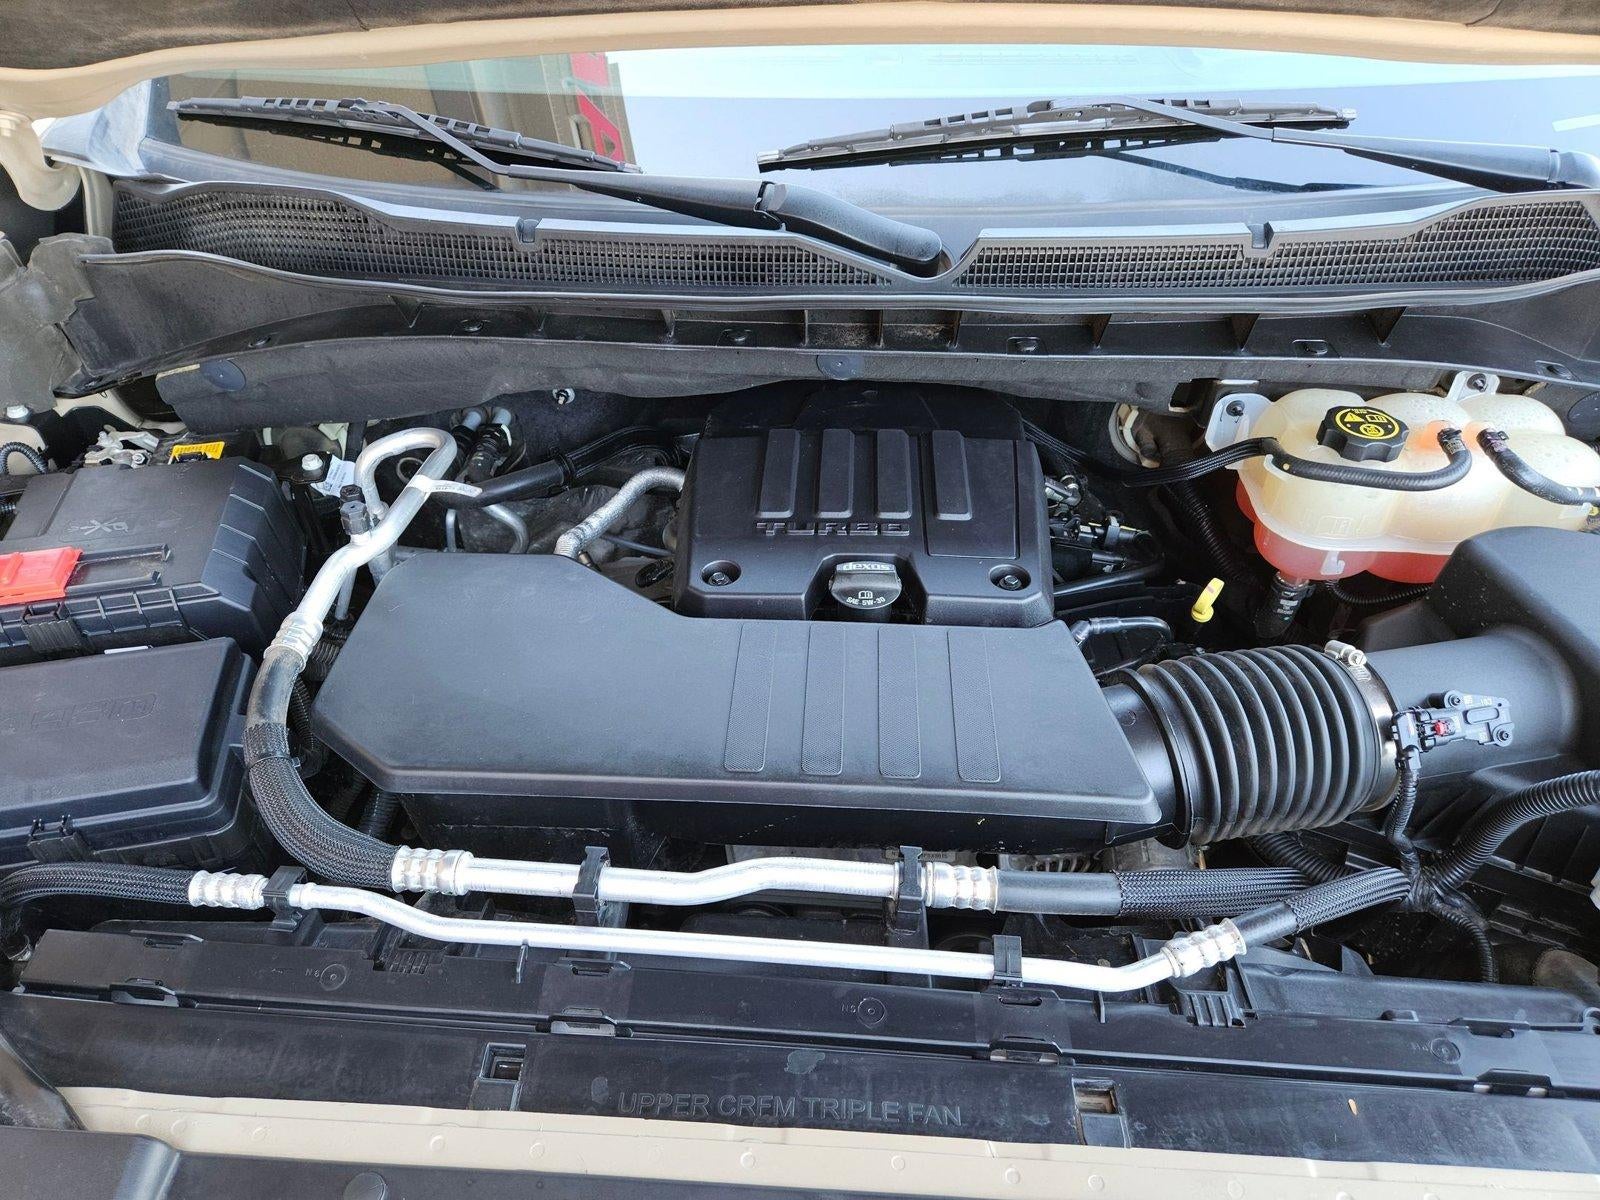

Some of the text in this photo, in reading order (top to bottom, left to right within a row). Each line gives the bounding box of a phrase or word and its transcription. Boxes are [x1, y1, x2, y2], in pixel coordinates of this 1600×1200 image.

[842, 561, 891, 571] dexos
[846, 596, 886, 606] SAE 5W-30
[617, 1091, 962, 1126] UPPER CRFM TRIPLE FAN
